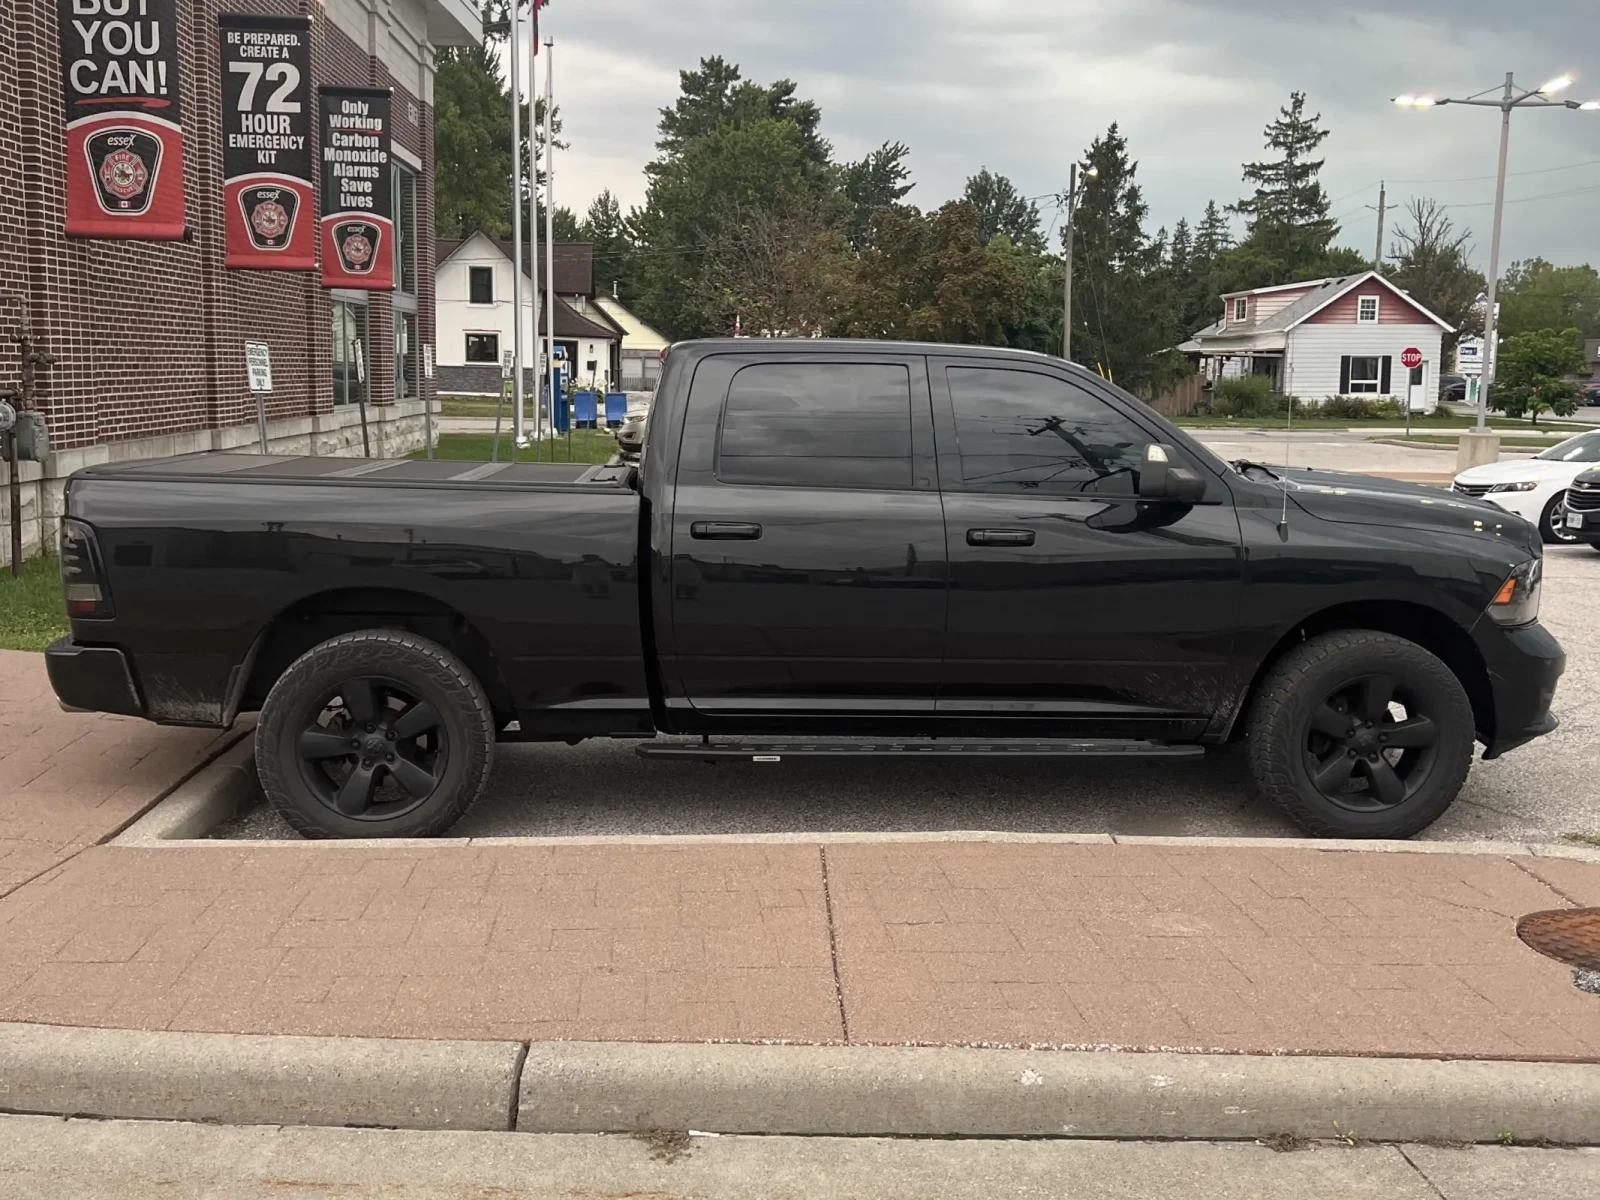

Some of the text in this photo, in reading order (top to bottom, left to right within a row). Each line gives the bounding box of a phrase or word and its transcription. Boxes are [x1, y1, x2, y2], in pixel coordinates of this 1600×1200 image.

[71, 20, 160, 55] YOU
[227, 32, 301, 46] BE PREPARED.
[239, 45, 290, 59] CREATE A
[70, 59, 168, 95] CAN!
[228, 61, 302, 113] 72
[341, 100, 369, 116] Only
[241, 113, 292, 135] HOUR
[329, 114, 383, 131] Working
[107, 134, 137, 149] essex
[228, 134, 305, 150] EMERGENCY
[332, 132, 380, 148] Carbon
[257, 150, 277, 164] KIT
[324, 147, 388, 163] Monoxide
[333, 163, 380, 178] Alarms
[341, 178, 373, 193] Save
[340, 193, 374, 208] Lives
[1401, 353, 1421, 362] STOP
